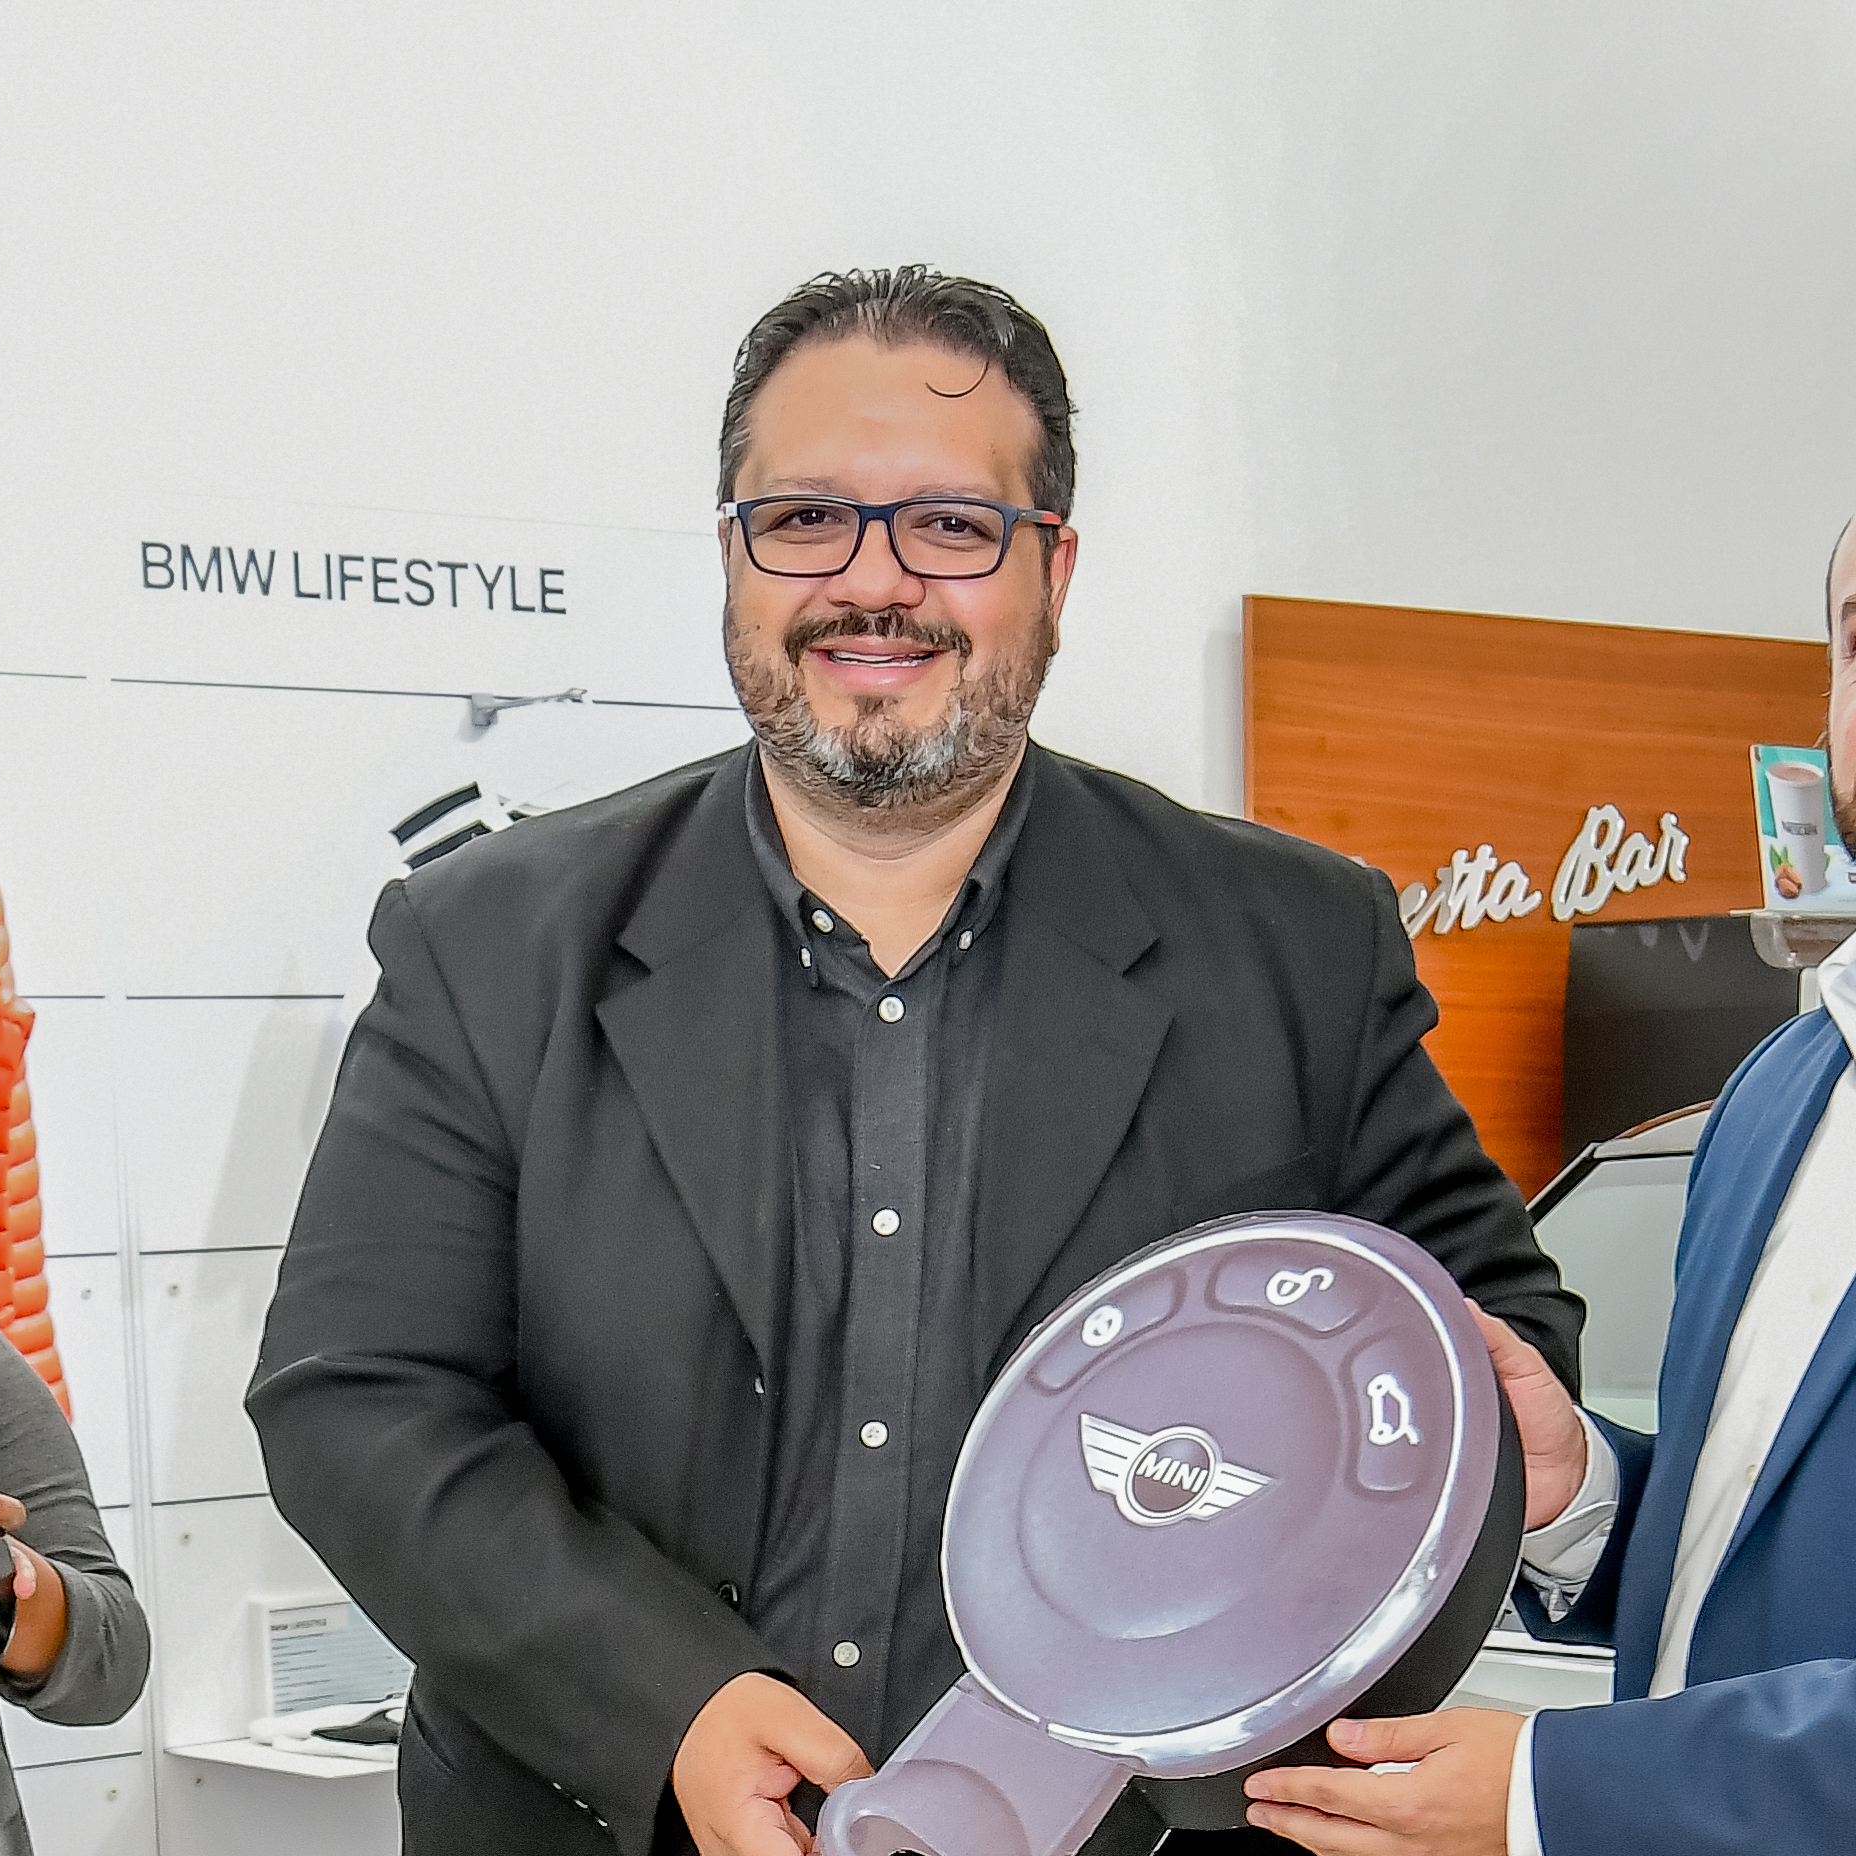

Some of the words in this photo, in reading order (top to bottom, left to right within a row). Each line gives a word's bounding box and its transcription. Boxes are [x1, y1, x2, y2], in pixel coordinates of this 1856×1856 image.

[141, 541, 276, 597] BMW
[292, 550, 567, 615] LIFESTYLE
[1550, 804, 1690, 922] Bar
[1135, 1451, 1209, 1493] MINI
